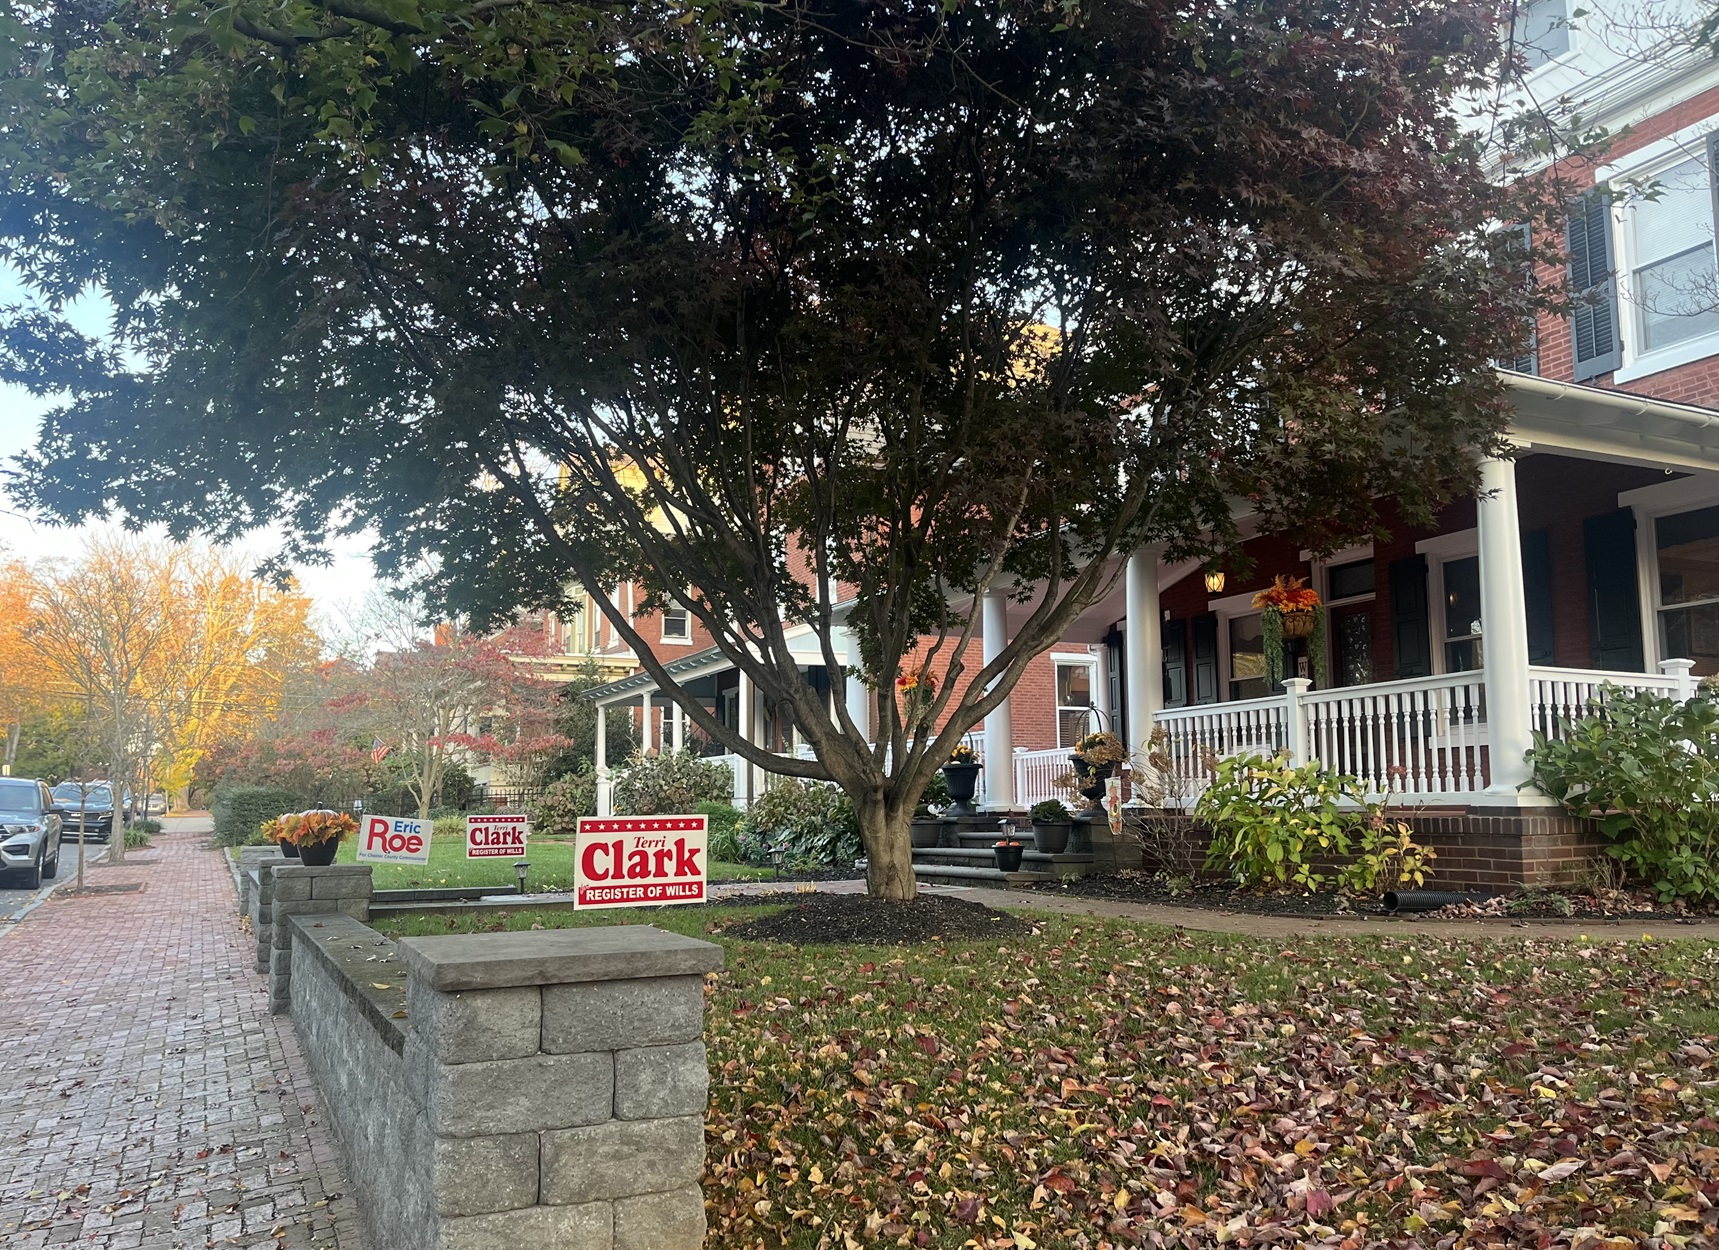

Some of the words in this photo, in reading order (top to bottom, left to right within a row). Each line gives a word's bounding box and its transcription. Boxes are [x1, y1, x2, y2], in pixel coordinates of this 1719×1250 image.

[366, 818, 423, 854] Roe
[394, 821, 421, 834] Eric
[470, 826, 523, 846] Clark
[634, 836, 666, 848] Terri
[581, 838, 701, 881] Clark
[586, 887, 644, 901] REGISTER
[647, 886, 662, 897] OF
[666, 884, 699, 896] WILLS
